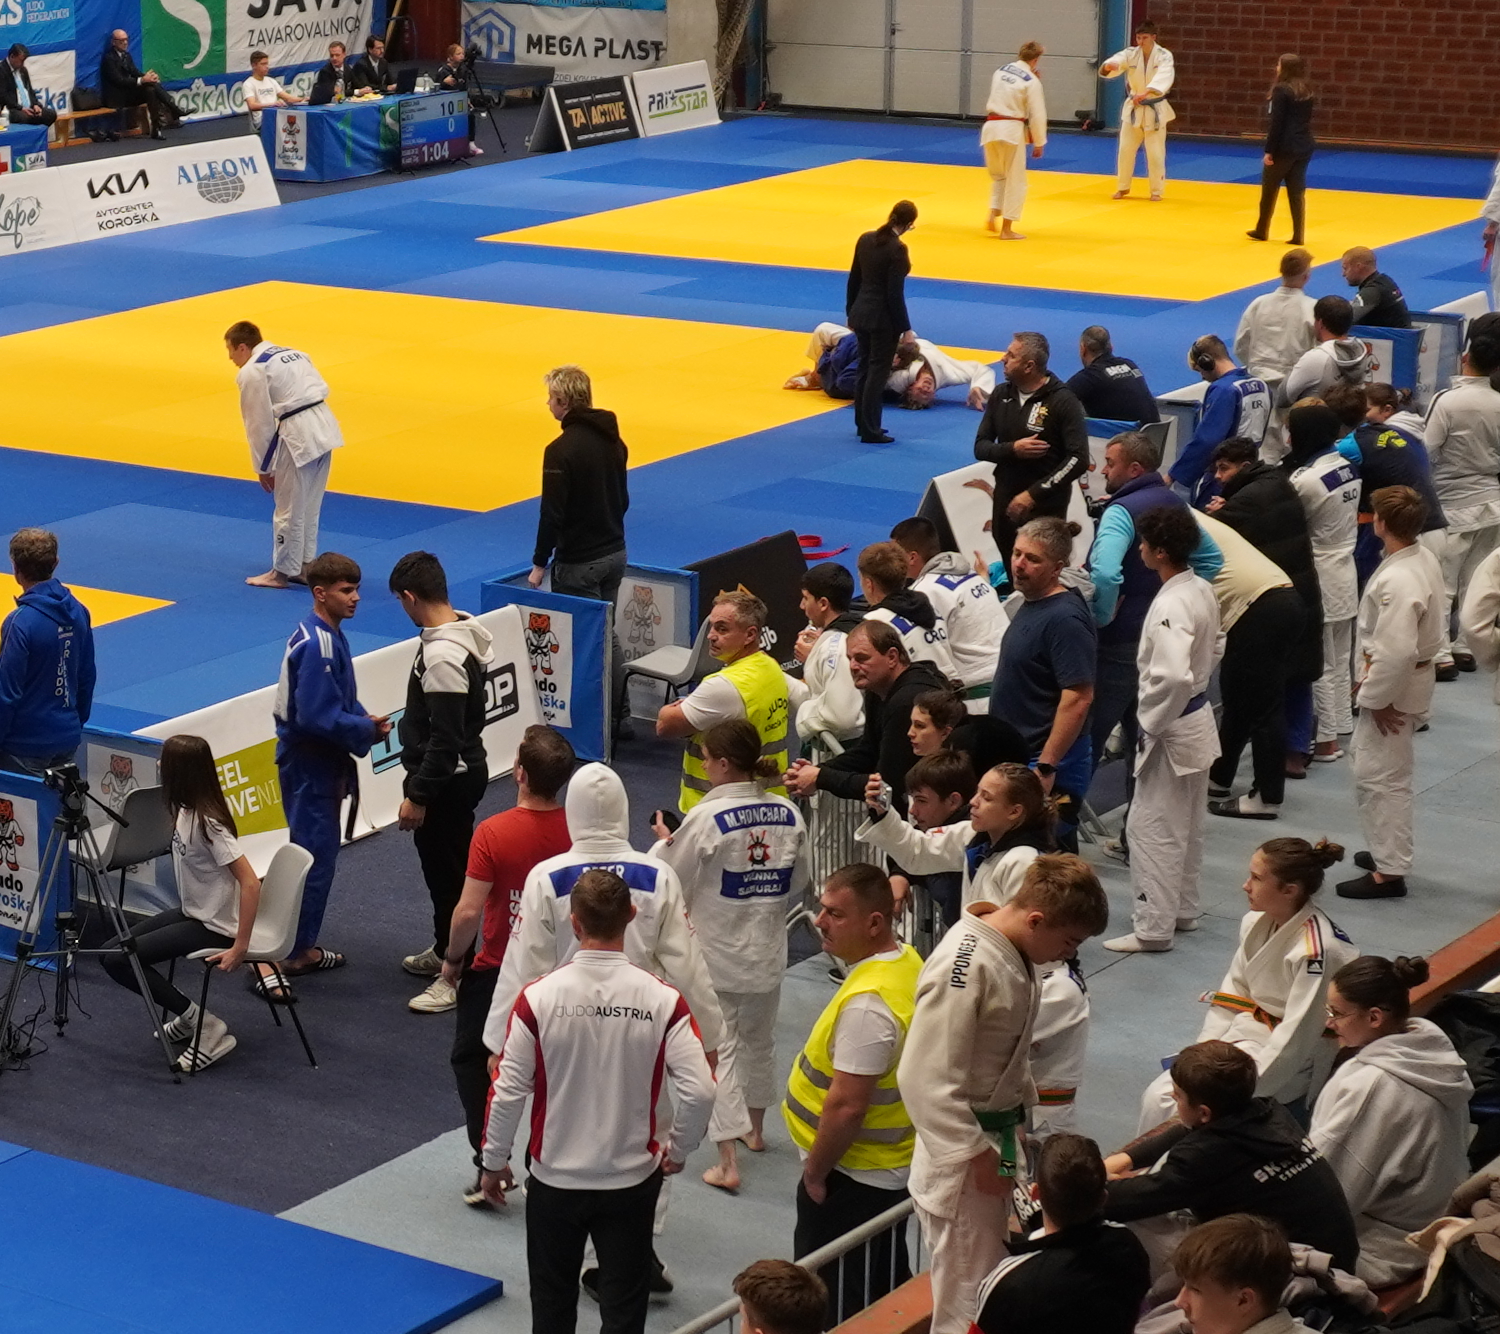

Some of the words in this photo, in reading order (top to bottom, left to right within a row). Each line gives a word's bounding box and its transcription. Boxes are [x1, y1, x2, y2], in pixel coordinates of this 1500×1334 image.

[26, 7, 70, 24] FEDERATION
[248, 12, 362, 48] ZAVAROVALNICA
[526, 33, 587, 57] MEGA
[594, 36, 666, 62] PLAST
[421, 144, 449, 163] 1:04
[177, 155, 259, 186] ALFOM
[95, 202, 154, 219] AVTOCENTER
[97, 210, 160, 232] KOROŠKA
[970, 583, 989, 600] CRO
[924, 627, 946, 644] CRO
[218, 760, 249, 791] EEL
[723, 805, 788, 831] M.HONCHAR
[951, 933, 978, 988] IPPONGEAR
